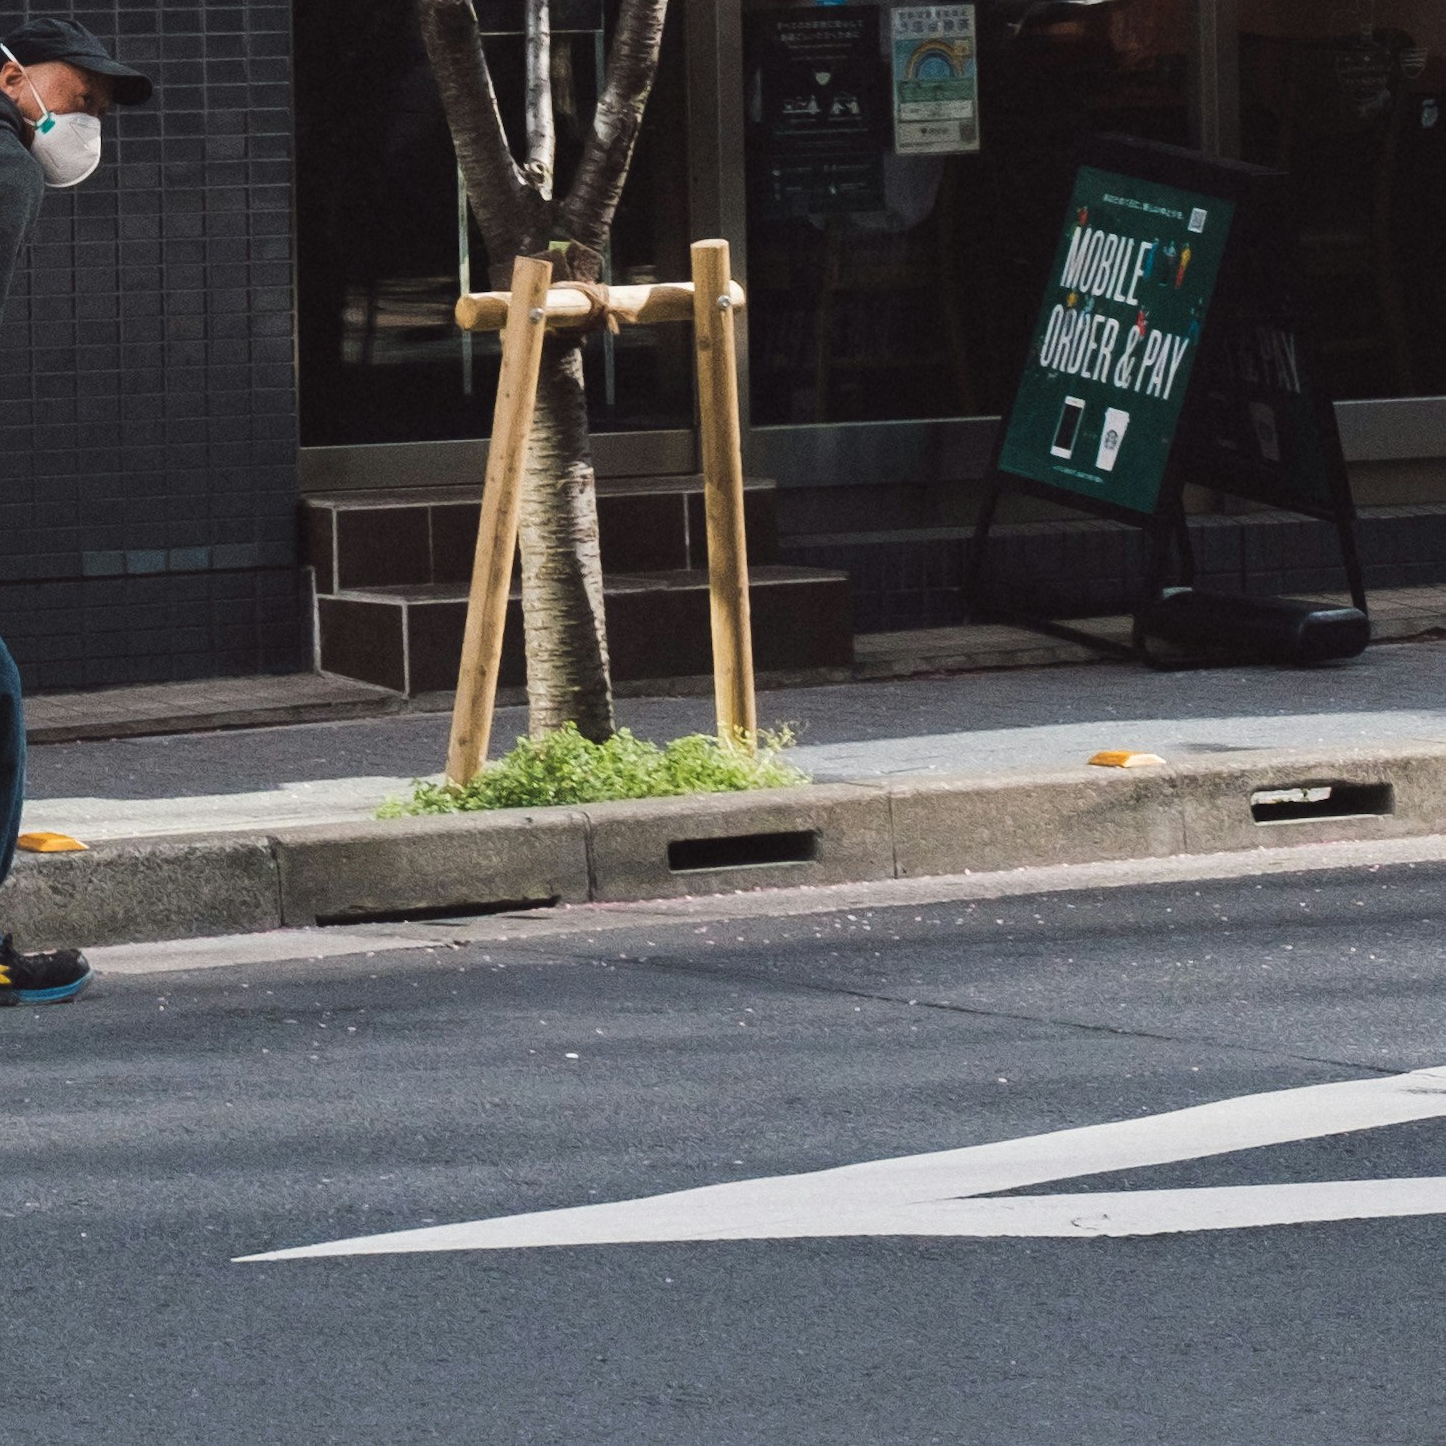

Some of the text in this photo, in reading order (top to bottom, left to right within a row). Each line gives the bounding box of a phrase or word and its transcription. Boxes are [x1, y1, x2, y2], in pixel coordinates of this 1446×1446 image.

[1060, 226, 1153, 306] MOBILE
[1039, 304, 1119, 383] ORDER
[1114, 324, 1141, 389] &
[1134, 329, 1190, 400] PAY
